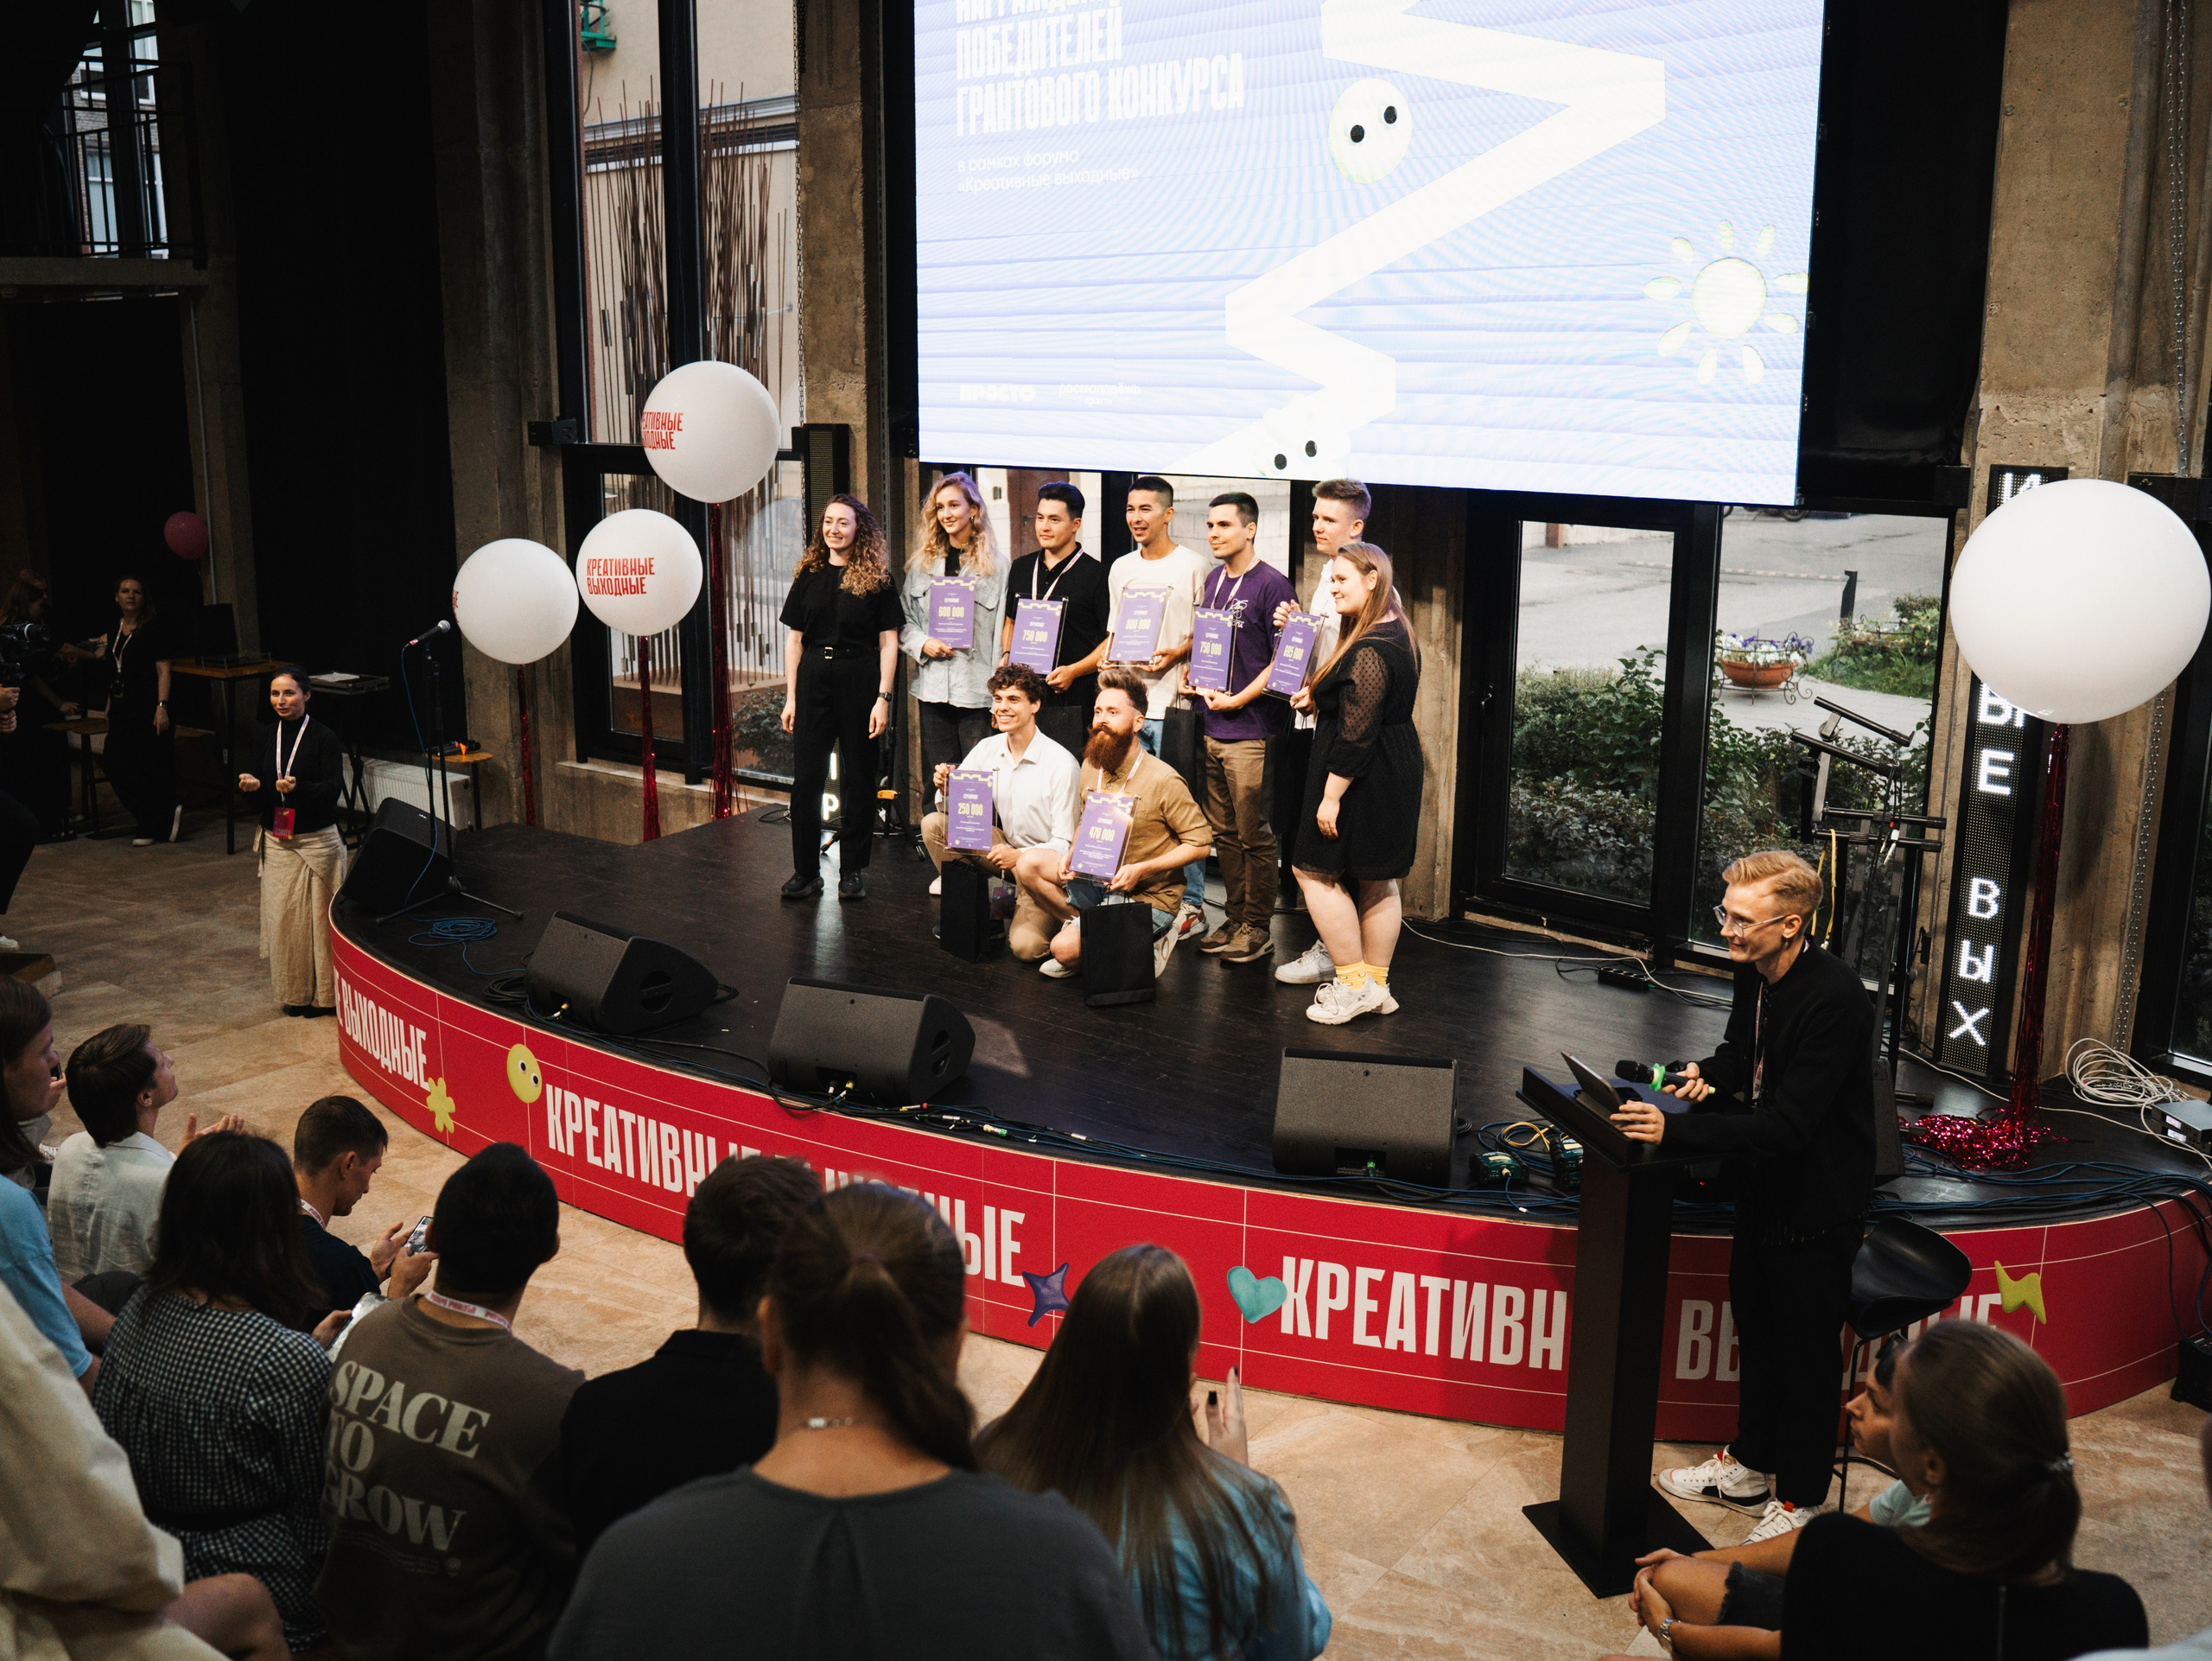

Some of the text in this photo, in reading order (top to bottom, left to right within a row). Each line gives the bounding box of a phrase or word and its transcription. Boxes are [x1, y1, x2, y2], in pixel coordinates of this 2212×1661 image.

[957, 0, 1122, 80] ПОБЕДИТЕЛЕЙ
[957, 53, 1244, 137] ГРАНТОВОГО КОНКУРСА
[957, 150, 1079, 174] в рамках форума
[587, 557, 655, 576] КРЕАТИВНЫЕ
[587, 576, 647, 597] ВЫХОДНЫЕ
[1022, 629, 1048, 643] 750 000
[1199, 640, 1211, 654] 750
[957, 802, 983, 817] 250 000
[1089, 826, 1116, 843] 470 000
[341, 977, 431, 1092] ВЫХОДНЫЕ
[545, 1084, 761, 1198] КРЕАТИВН
[1281, 1256, 1567, 1371] КРЕАТИВН
[329, 1359, 491, 1459] SPACE
[328, 1411, 374, 1473] TO
